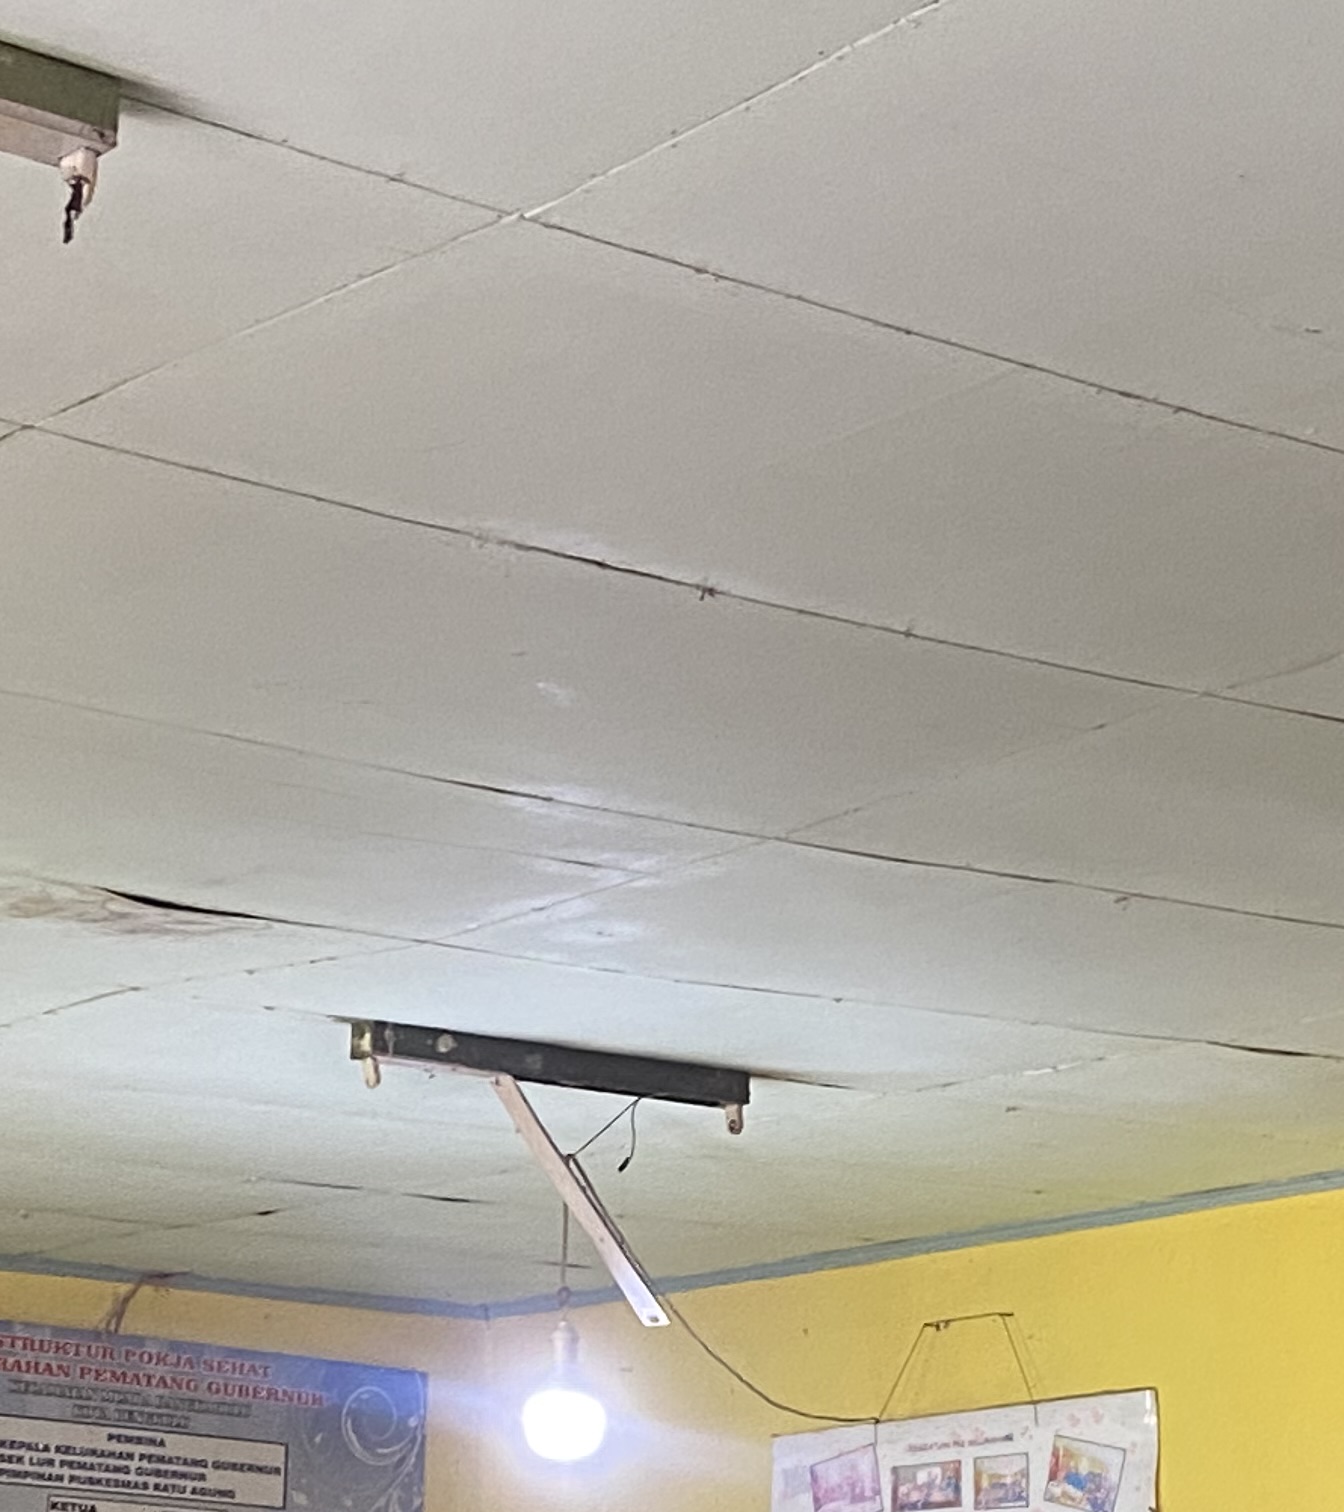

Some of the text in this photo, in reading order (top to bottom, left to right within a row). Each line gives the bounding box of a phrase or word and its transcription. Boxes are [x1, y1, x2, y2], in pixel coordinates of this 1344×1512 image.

[124, 1350, 195, 1371] POKJA
[201, 1358, 272, 1380] SEHAT
[79, 1367, 200, 1393] PEMATANG
[206, 1381, 325, 1408] GUBERNUR
